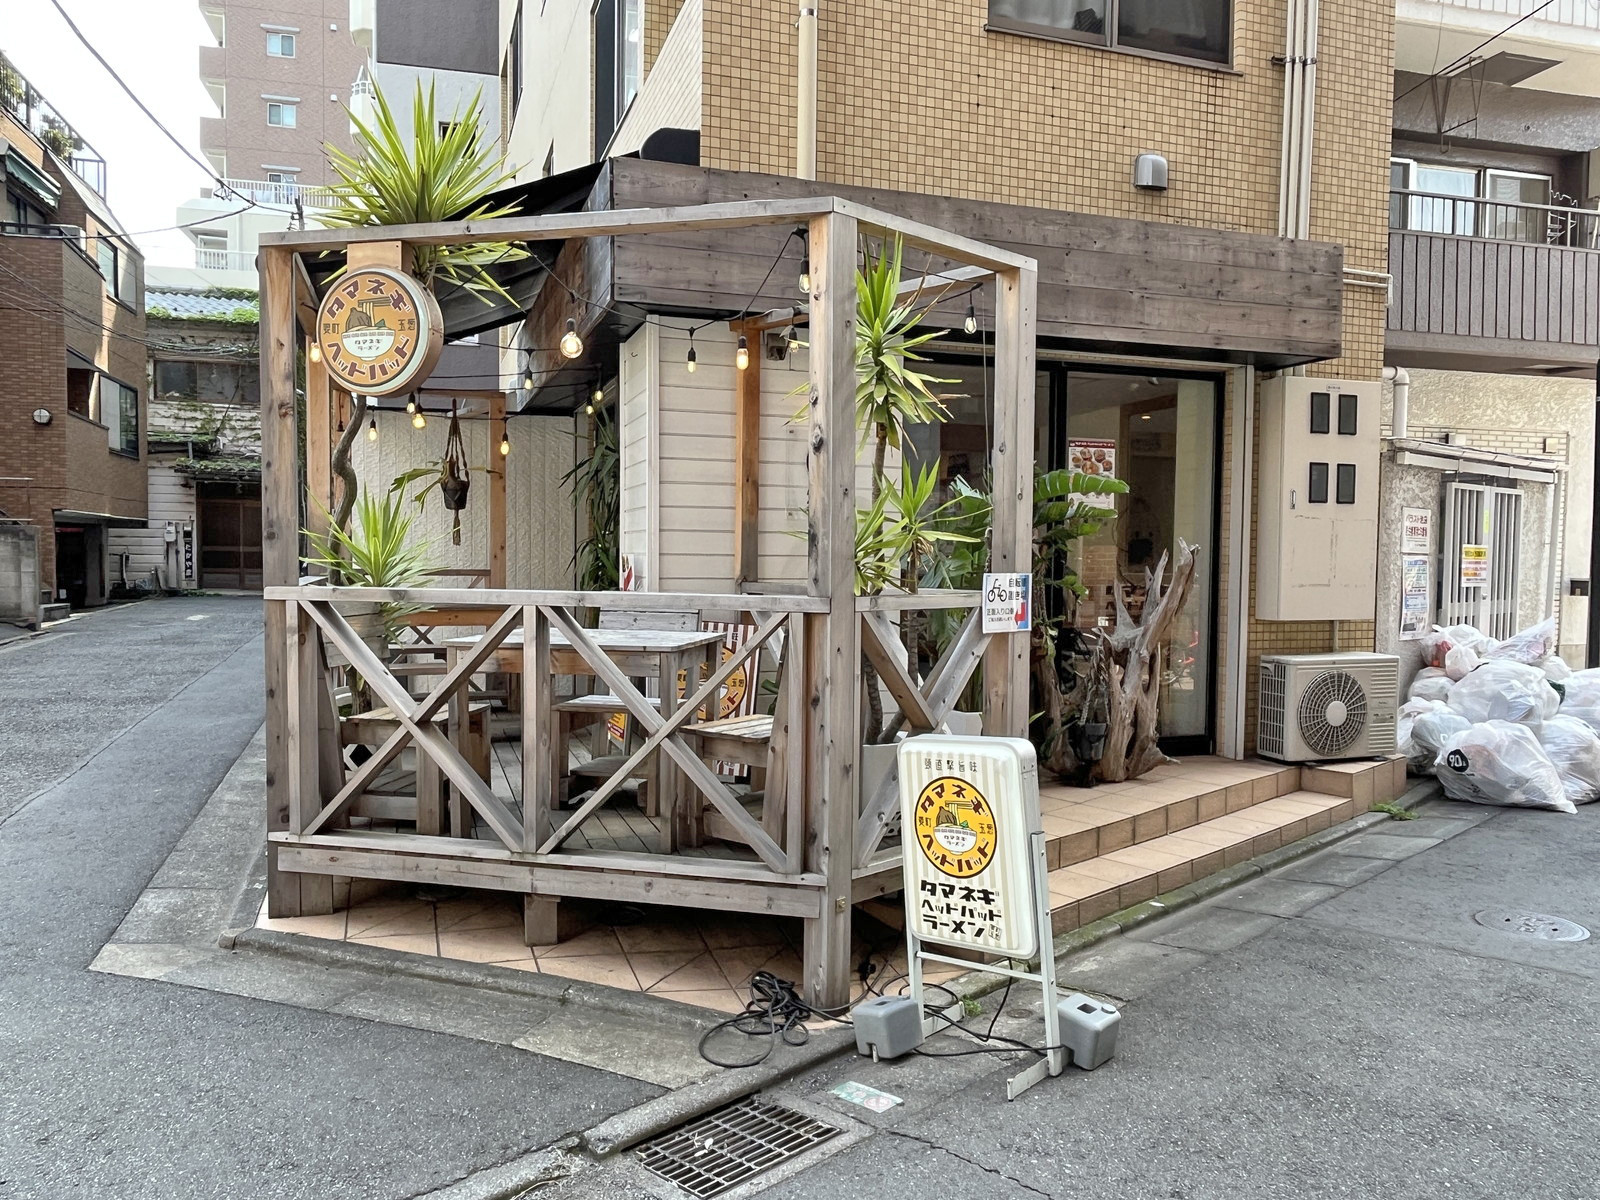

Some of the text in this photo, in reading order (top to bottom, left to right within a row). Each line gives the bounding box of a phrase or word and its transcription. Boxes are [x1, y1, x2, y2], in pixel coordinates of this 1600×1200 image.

[326, 279, 411, 319] タマネギ
[920, 782, 989, 817] タマネギ
[920, 880, 1000, 906] タマネギ
[922, 914, 986, 938] ラーメン
